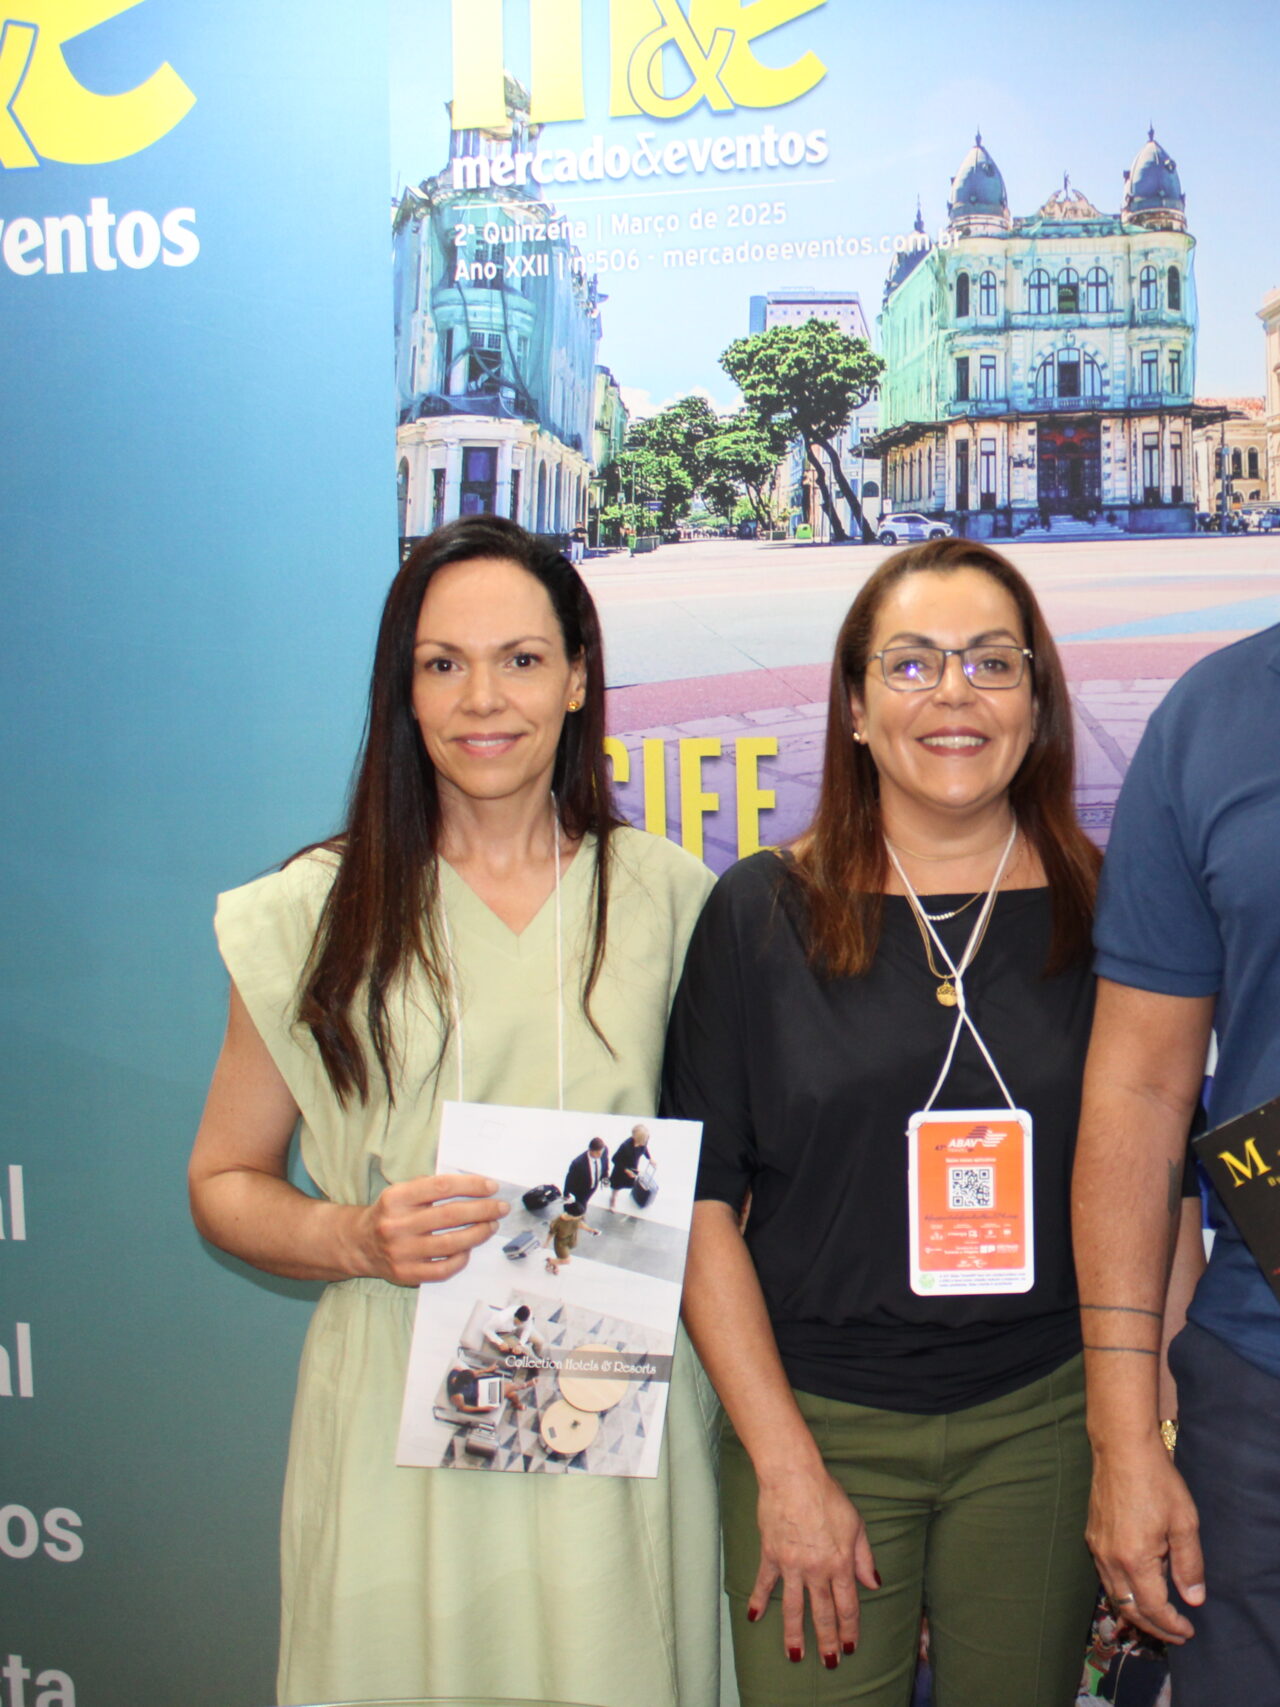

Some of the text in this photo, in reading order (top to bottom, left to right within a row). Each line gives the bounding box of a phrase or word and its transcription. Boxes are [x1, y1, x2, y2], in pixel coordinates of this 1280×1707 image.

[451, 126, 829, 190] mercado&eventos
[0, 197, 201, 276] entos
[483, 219, 587, 245] Quinzena
[611, 212, 680, 234] Março
[689, 208, 718, 230] de
[726, 201, 787, 228] 2025
[454, 259, 497, 281] Ano
[505, 254, 549, 278] XXII
[663, 227, 963, 268] mercadoeeventos.com.br
[505, 1355, 657, 1375] Collection Hotels & Resorts
